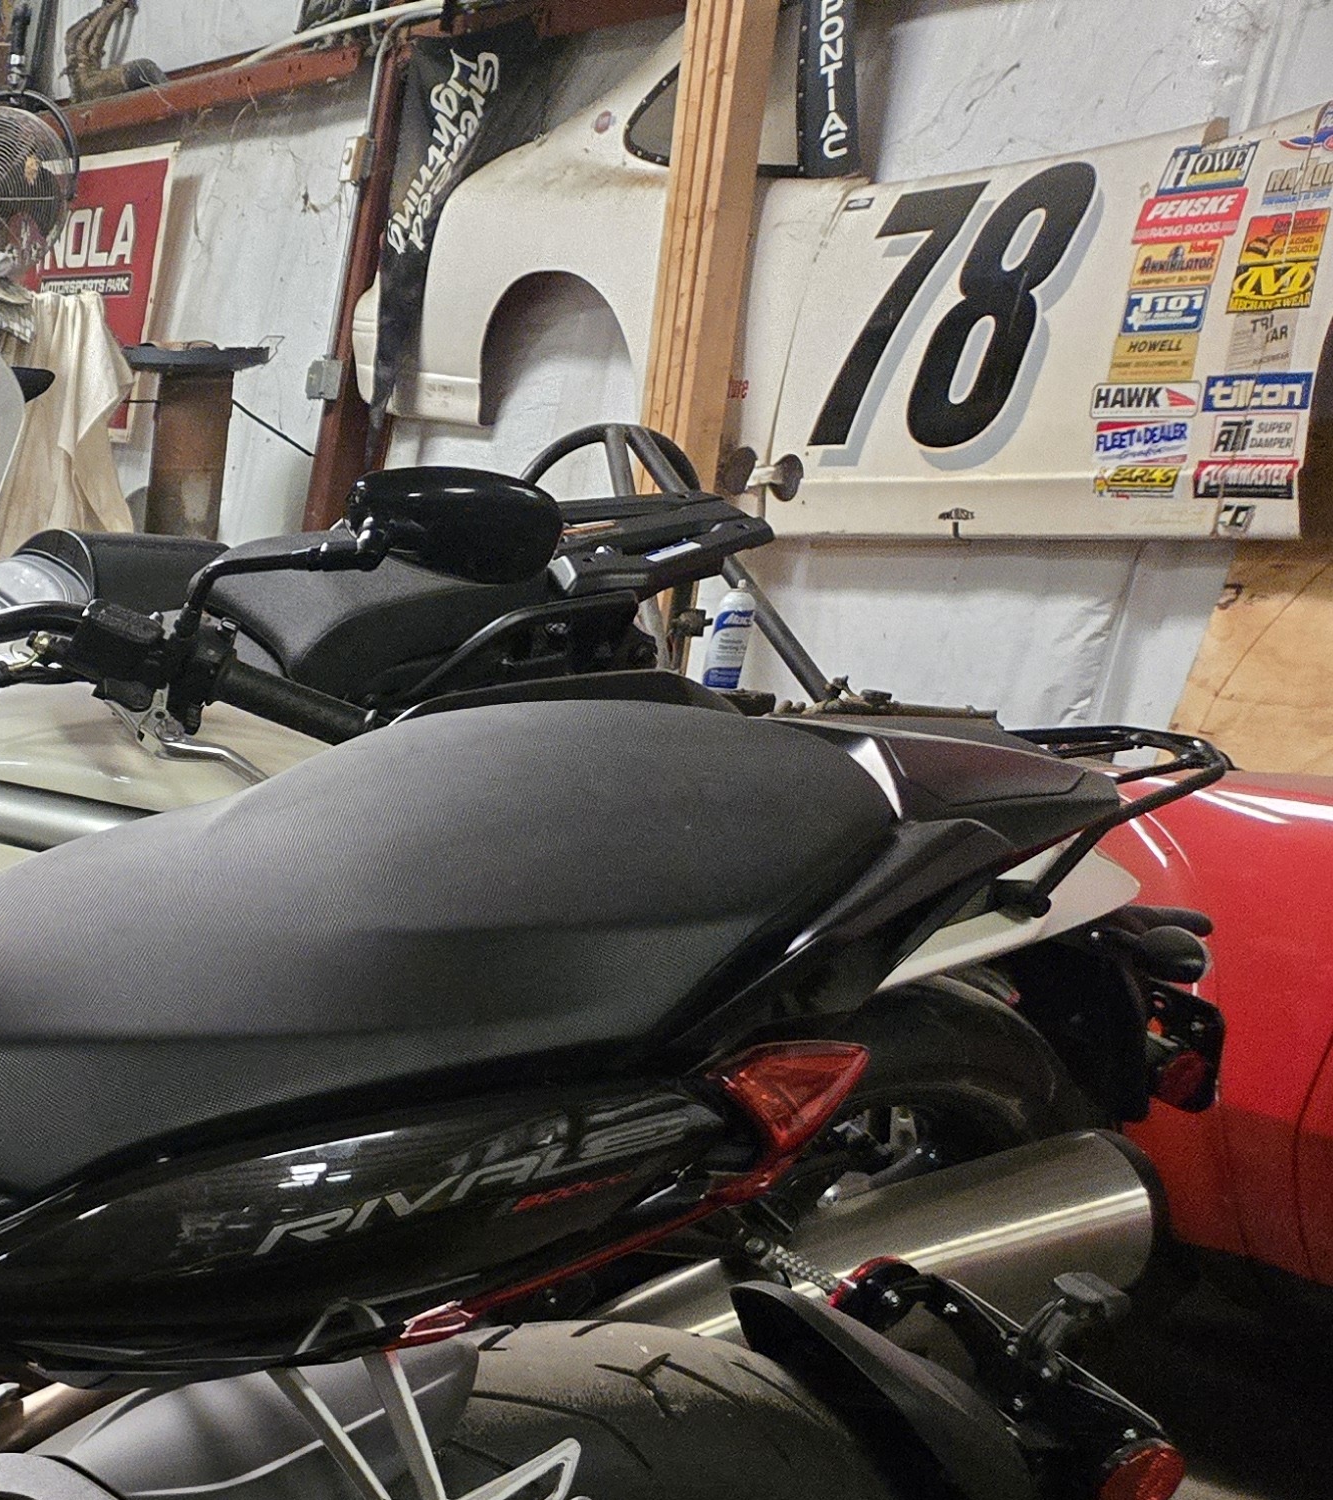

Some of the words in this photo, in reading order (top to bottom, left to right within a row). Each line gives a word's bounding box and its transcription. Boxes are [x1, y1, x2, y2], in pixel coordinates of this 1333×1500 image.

[820, 0, 848, 159] PONTIAC
[1146, 193, 1239, 222] PENSKE
[808, 161, 1098, 448] 78
[1127, 338, 1183, 353] HOWELL
[1094, 387, 1163, 409] HAWK
[1096, 428, 1135, 452] FLEET
[1143, 422, 1187, 445] DEALER
[1255, 421, 1291, 434] SUPER
[1250, 436, 1294, 450] DAMPER
